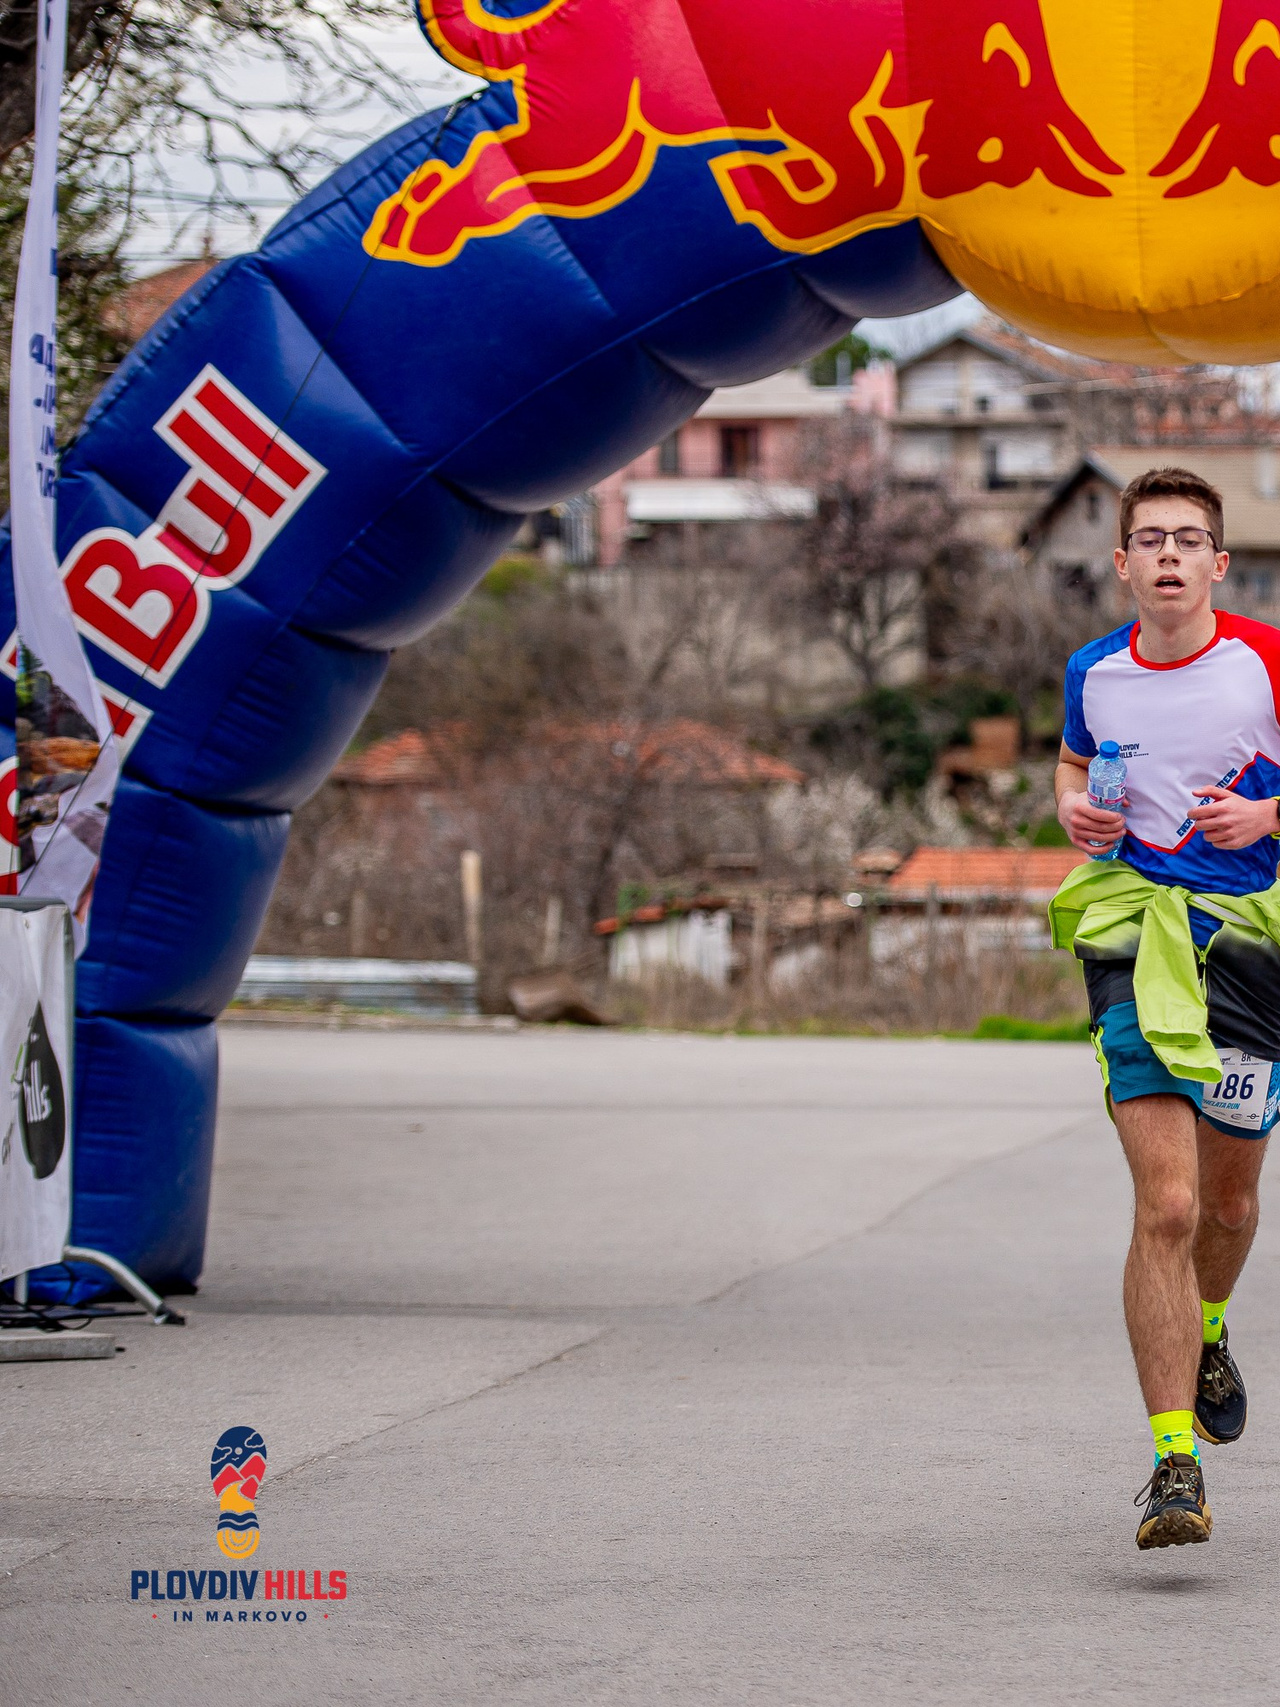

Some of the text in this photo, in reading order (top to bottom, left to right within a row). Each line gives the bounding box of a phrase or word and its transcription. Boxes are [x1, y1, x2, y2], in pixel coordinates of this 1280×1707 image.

[60, 371, 318, 681] Bull
[1118, 743, 1140, 752] LOVDIV
[1212, 1073, 1256, 1100] 186
